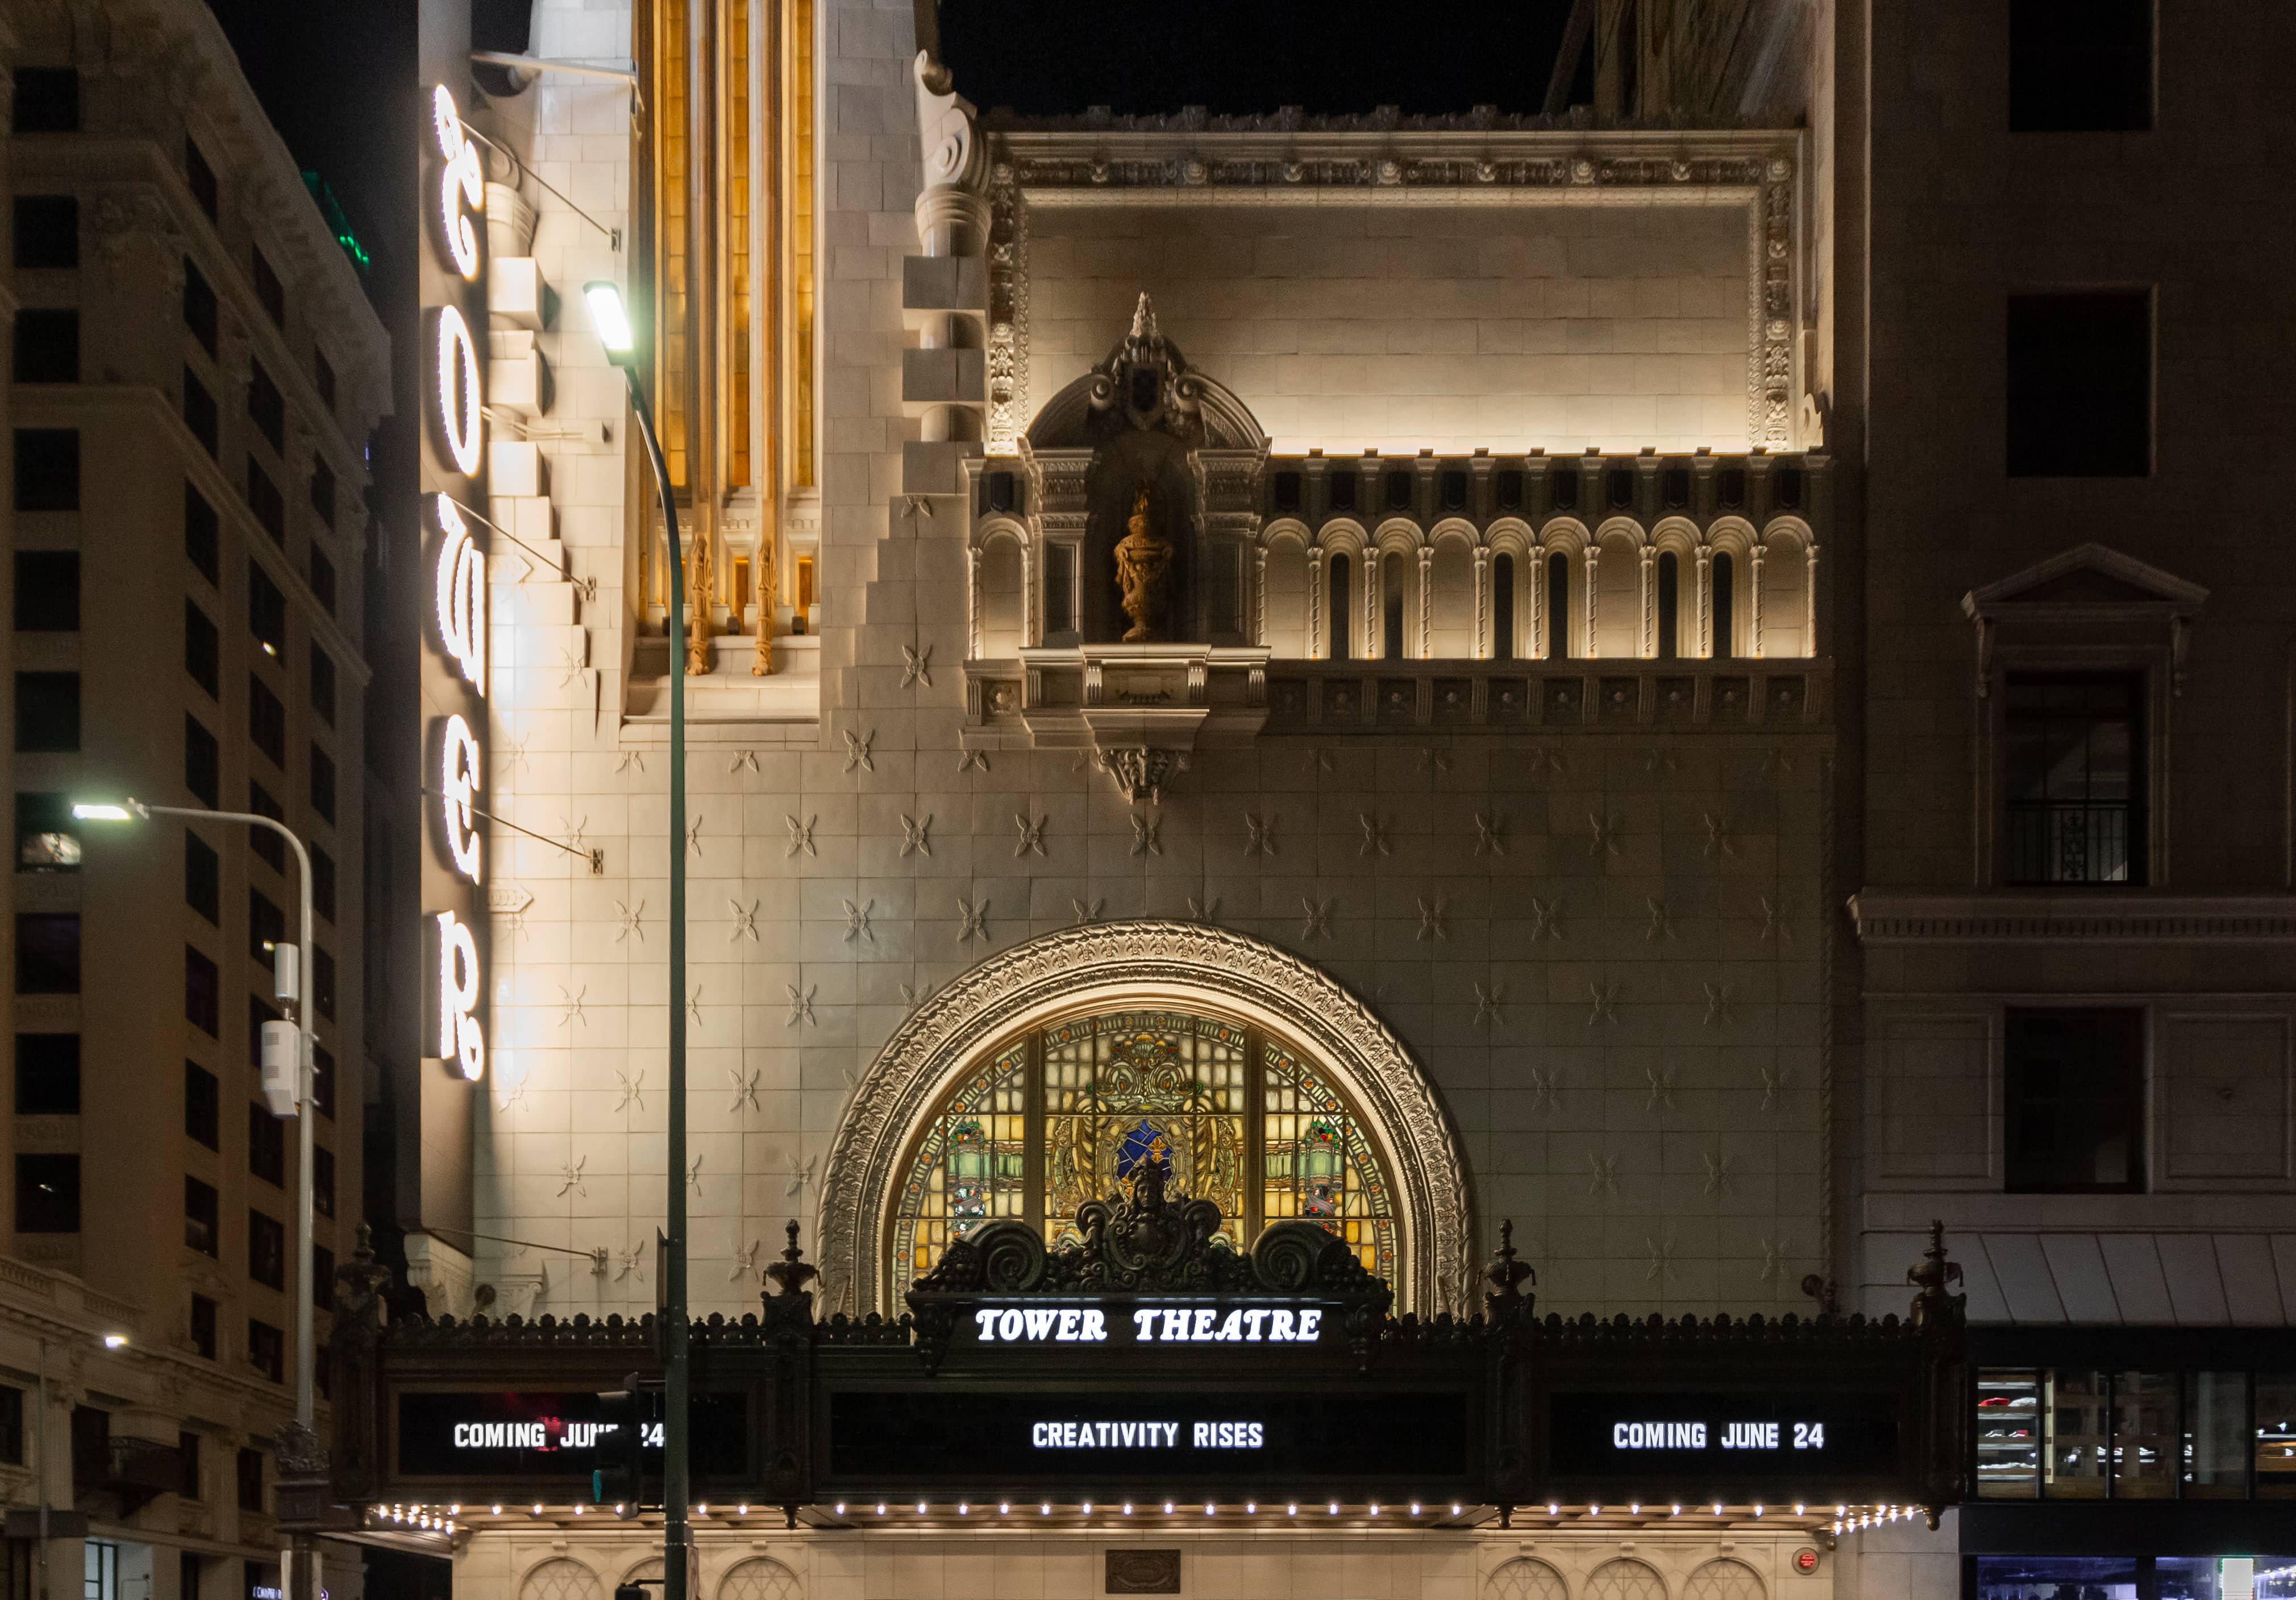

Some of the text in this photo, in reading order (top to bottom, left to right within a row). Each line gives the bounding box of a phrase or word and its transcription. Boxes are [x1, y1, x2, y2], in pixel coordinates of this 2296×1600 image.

[434, 84, 484, 1081] TOWER
[975, 1309, 1322, 1341] TOWER THEATRE
[454, 1423, 546, 1447] COMING
[560, 1423, 618, 1447] JUN
[1033, 1422, 1263, 1448] CREATIVITY RISES
[1613, 1423, 1824, 1448] COMING JUNE 24
